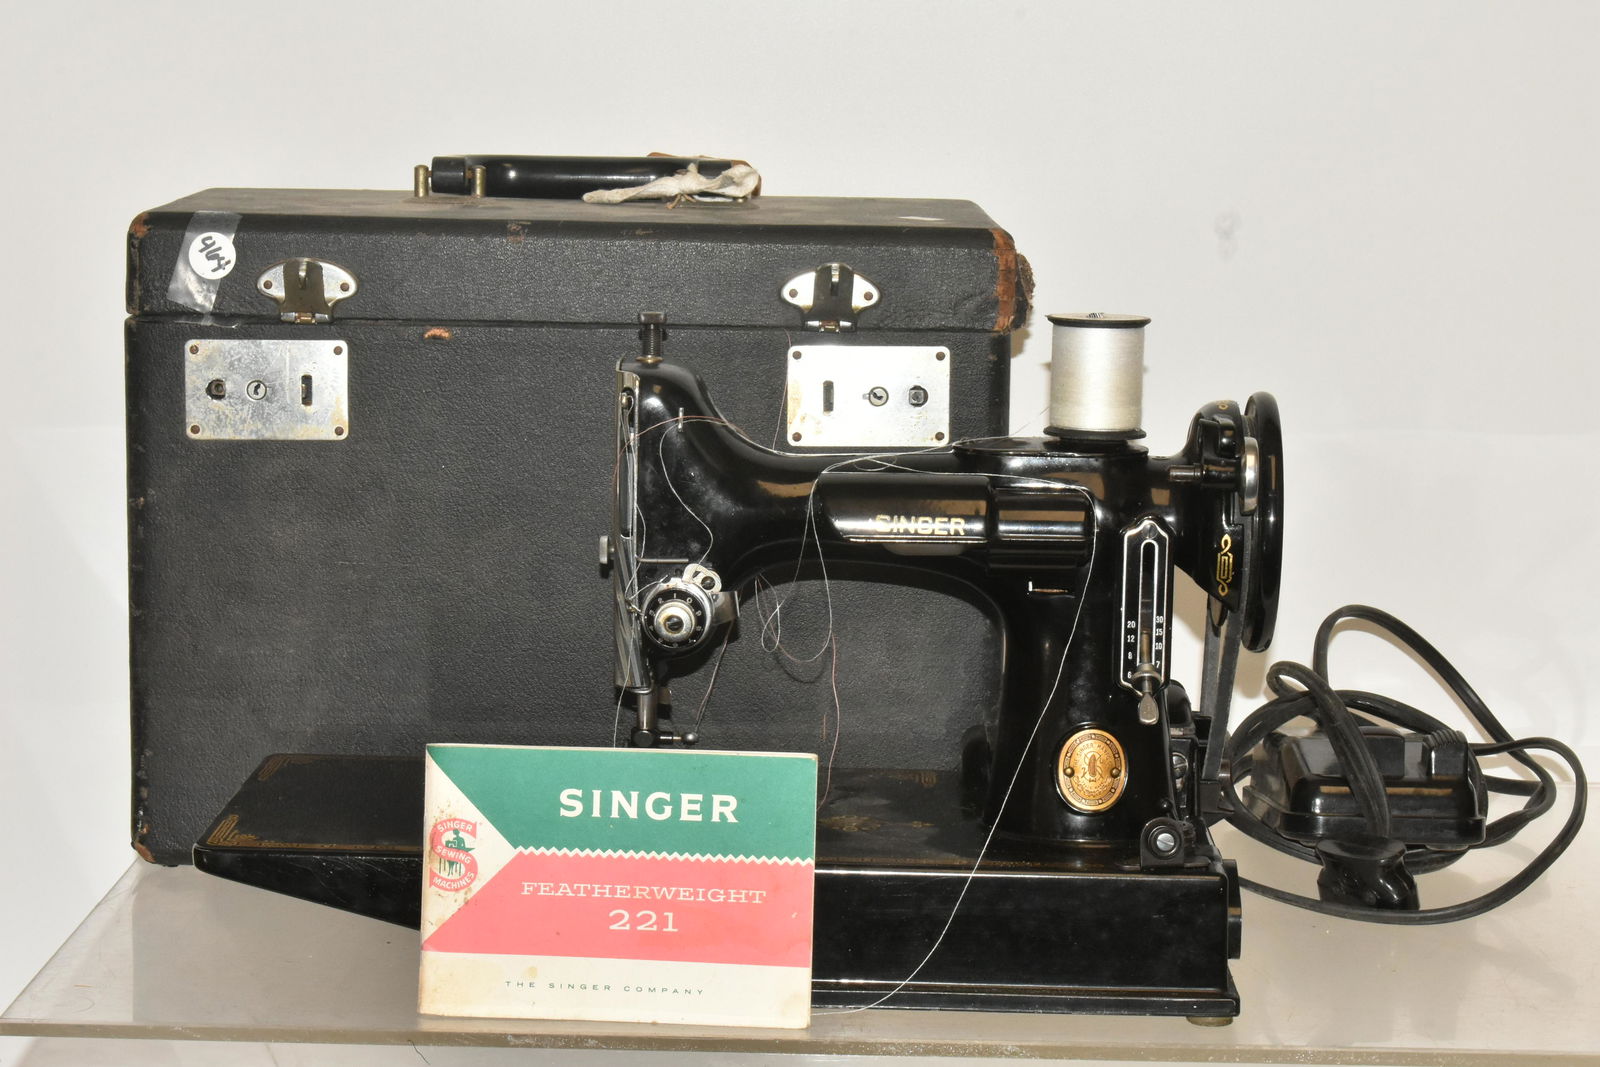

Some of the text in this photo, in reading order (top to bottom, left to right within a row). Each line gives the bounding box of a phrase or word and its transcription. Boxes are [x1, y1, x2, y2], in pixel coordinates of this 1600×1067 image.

[1127, 620, 1136, 629] 20
[1155, 628, 1163, 636] 15
[1155, 642, 1163, 650] 10
[1127, 651, 1133, 660] 8
[1156, 660, 1161, 668] 7
[1127, 671, 1132, 679] 6
[559, 788, 739, 823] SINGER
[437, 821, 473, 833] SINGER
[435, 845, 471, 864] SEWING
[433, 872, 475, 889] MACHINES
[520, 882, 767, 904] FEATHERWEIGHT
[608, 909, 679, 932] 221
[548, 982, 612, 991] SINGER
[623, 985, 704, 995] COMPANY
